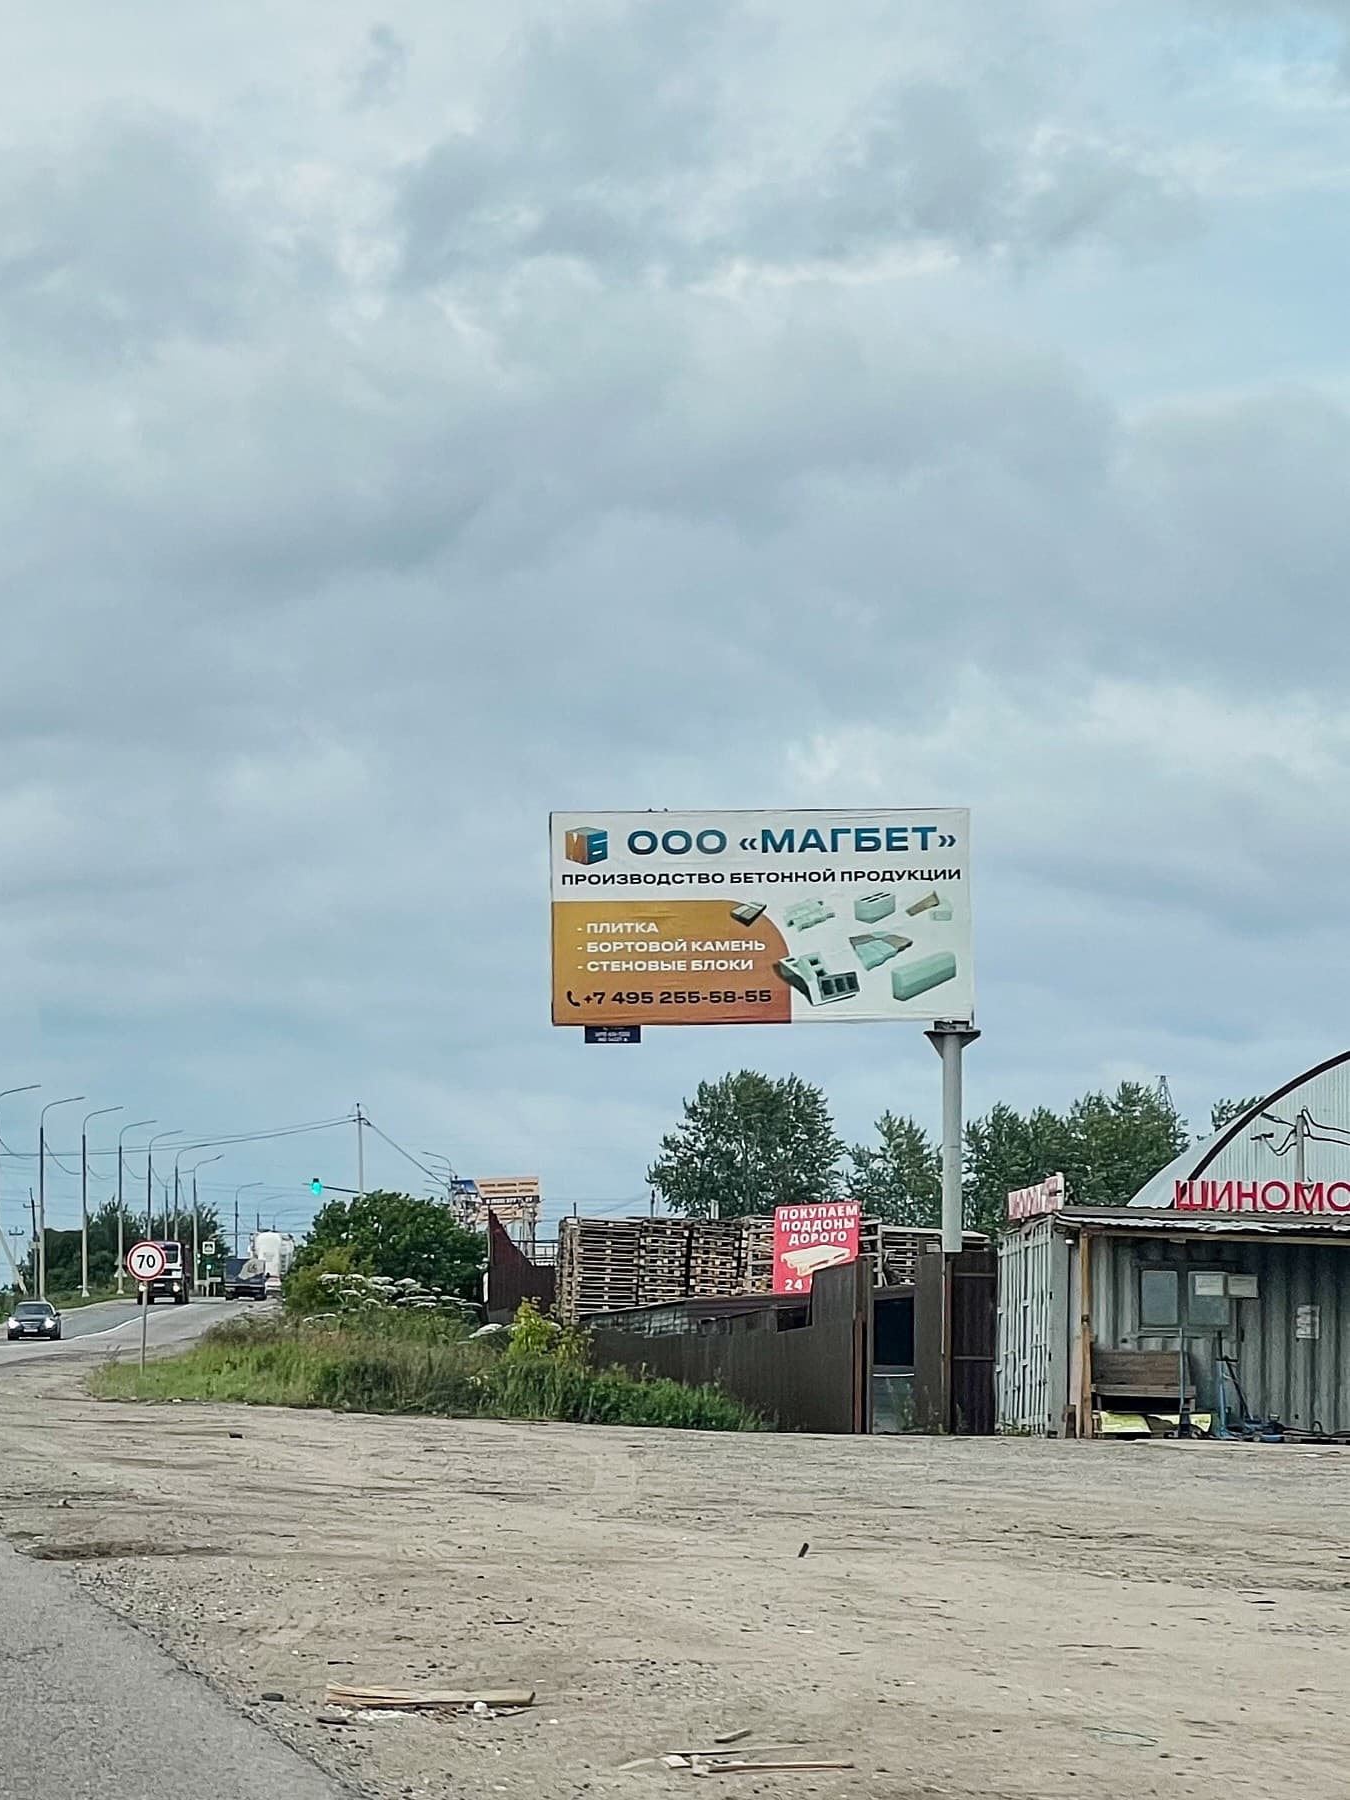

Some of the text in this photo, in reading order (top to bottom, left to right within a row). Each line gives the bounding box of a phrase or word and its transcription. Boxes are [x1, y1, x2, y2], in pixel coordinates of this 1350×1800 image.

[627, 825, 957, 856] ООО «МАГБЕТ»
[561, 868, 962, 886] ПРОИЗВОДСТВО БЕТОННОЙ ПРОДУКЦИИ
[586, 922, 659, 934] ПЛИТКА
[586, 939, 686, 953] БОРТОВОЙ
[690, 940, 766, 952] КАМЕНЬ
[586, 960, 687, 972] СТЕНОВЫЕ
[691, 960, 754, 972] БЛОКИ
[583, 990, 772, 1005] +7 495 255-58-55
[779, 1204, 858, 1220] ПОКУПАЕМ
[781, 1218, 855, 1233] ПОДДОНЫ
[788, 1231, 847, 1246] ДОРОГО
[136, 1254, 156, 1269] 70
[784, 1279, 803, 1291] 24
